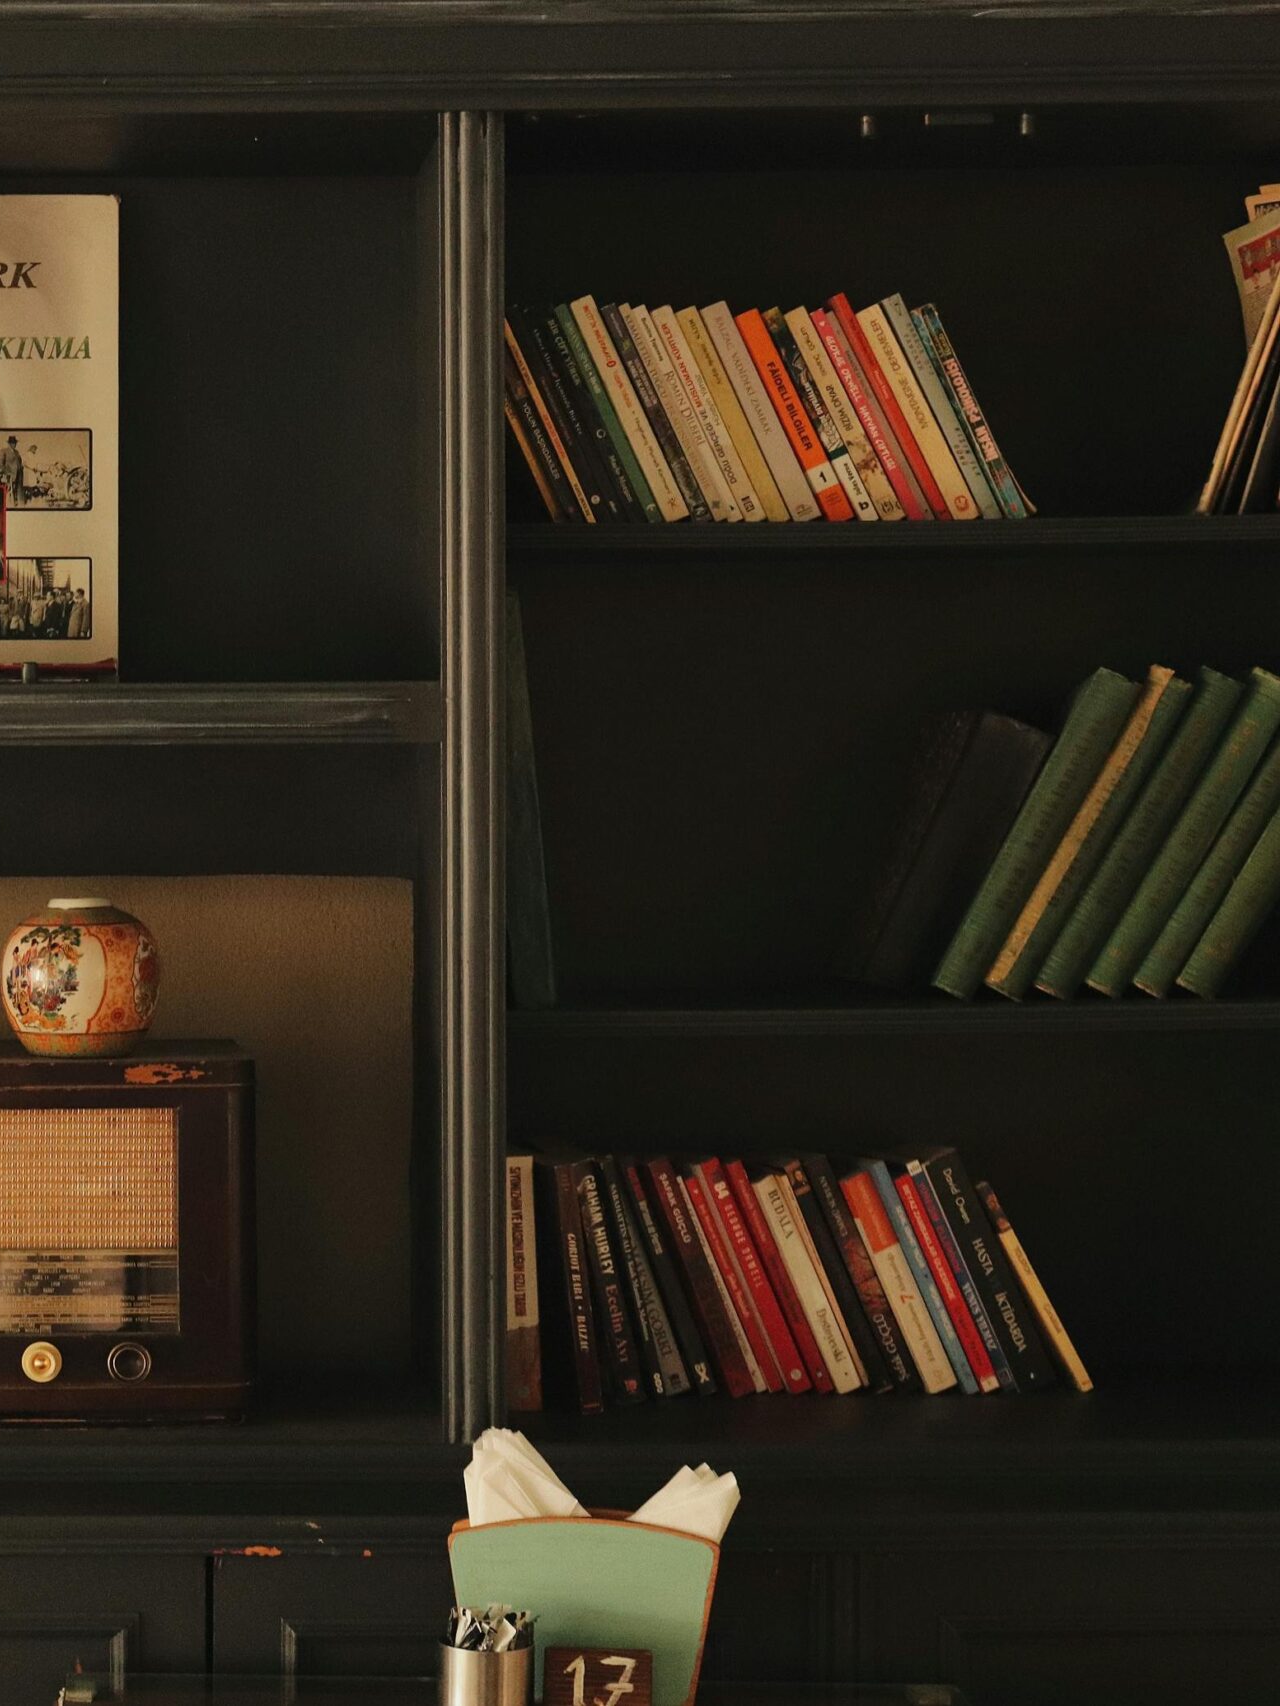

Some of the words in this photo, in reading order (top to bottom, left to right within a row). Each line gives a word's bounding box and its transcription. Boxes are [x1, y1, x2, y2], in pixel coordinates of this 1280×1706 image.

[663, 370, 688, 408] ROMEN
[824, 332, 847, 367] GEORGE
[840, 366, 863, 402] ORWELL
[858, 404, 879, 438] HAYVAN
[825, 383, 842, 408] DİYAR
[697, 408, 708, 421] VE
[836, 407, 853, 432] BİZİM
[841, 462, 854, 480] Verne
[849, 479, 862, 496] Jules
[767, 1189, 794, 1239] BUDALA
[942, 1167, 961, 1195] David
[954, 1196, 973, 1224] Owen
[582, 1174, 604, 1224] GRAHAM
[593, 1226, 614, 1275] HURLEY
[605, 1284, 625, 1333] Ecelin
[900, 1290, 915, 1304] 7
[970, 1237, 996, 1276] HASTA
[994, 1291, 1029, 1353] İKTİDARDA
[563, 1654, 637, 1706] 17
